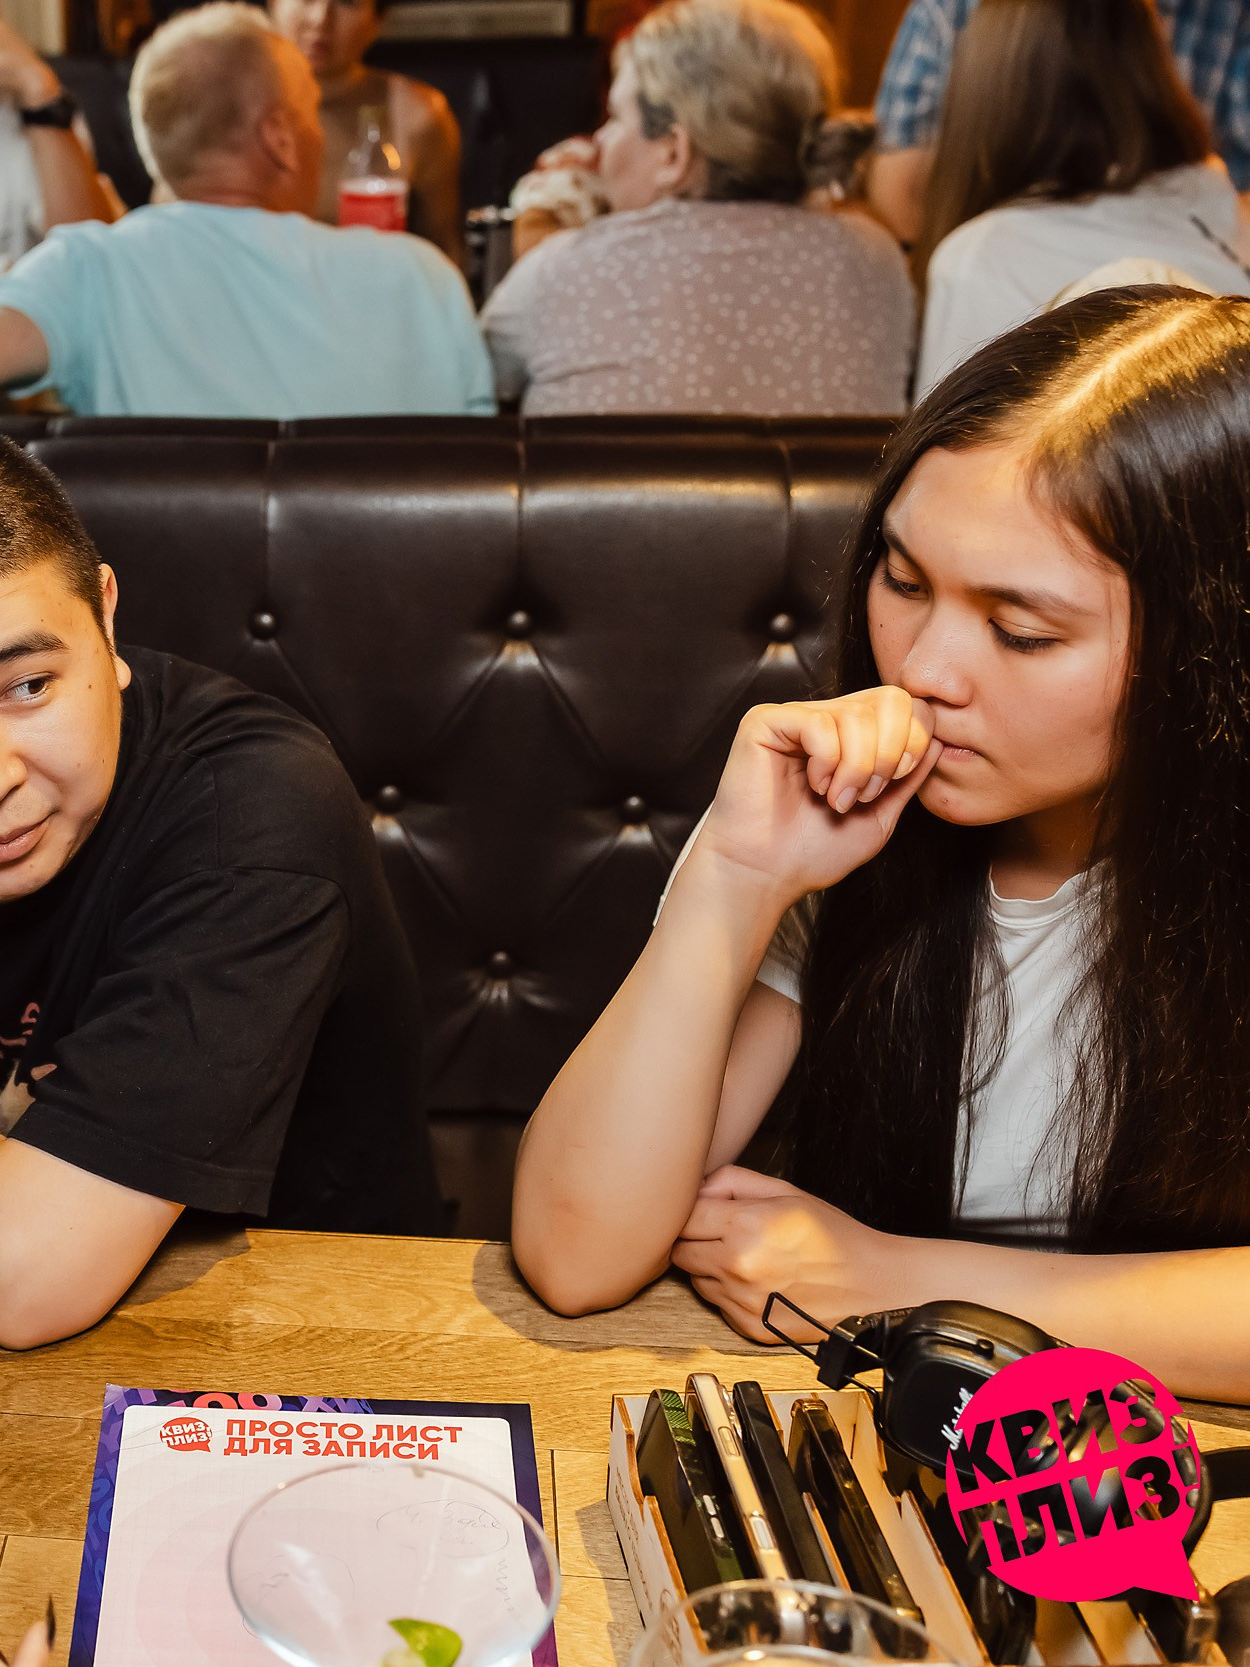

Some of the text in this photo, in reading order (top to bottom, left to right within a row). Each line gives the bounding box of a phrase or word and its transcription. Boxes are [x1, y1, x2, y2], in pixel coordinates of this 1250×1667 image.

[225, 1418, 463, 1443] ПРОСТО ЛИСТ
[223, 1436, 440, 1461] ДЛЯ ЗАПИСИ
